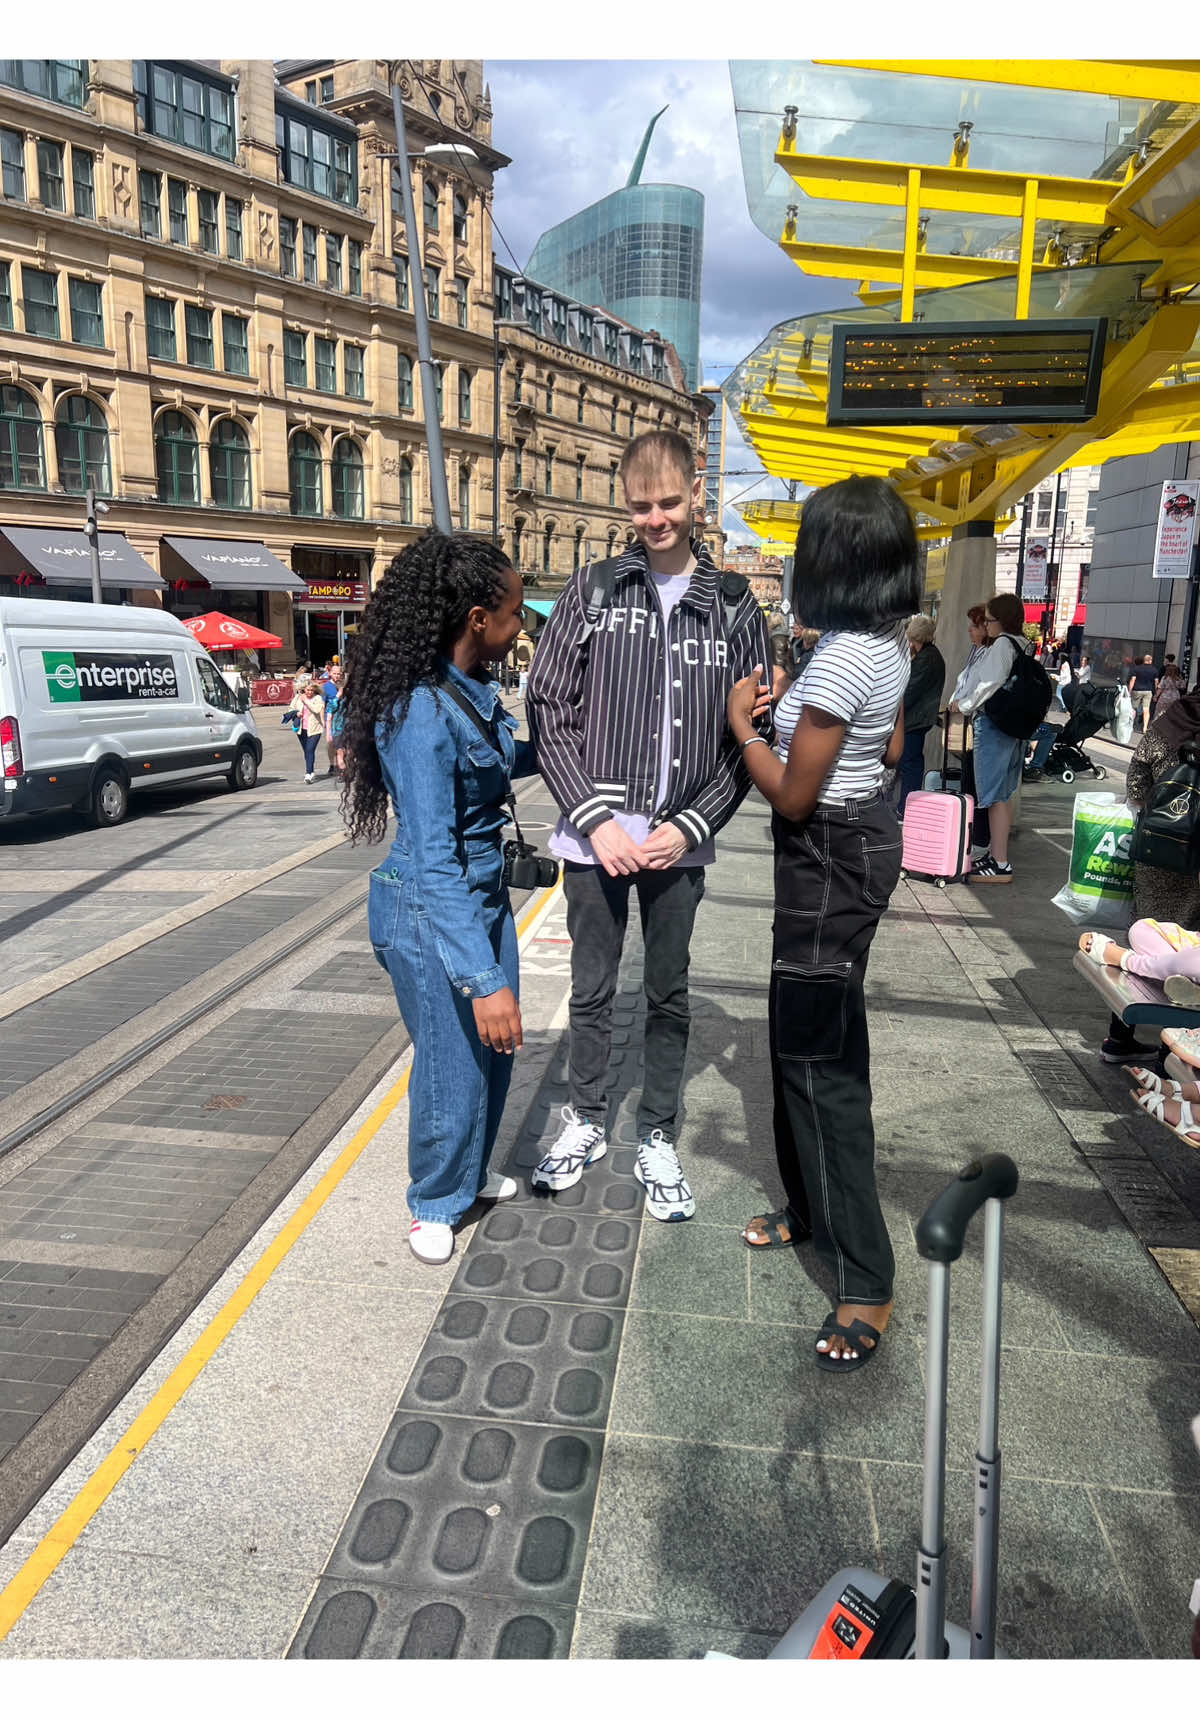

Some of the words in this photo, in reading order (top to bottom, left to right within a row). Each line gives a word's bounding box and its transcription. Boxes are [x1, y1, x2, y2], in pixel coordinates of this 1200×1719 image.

[41, 546, 117, 556] VAPIAO
[46, 661, 175, 693] enterprise
[138, 687, 176, 697] rent-a-car
